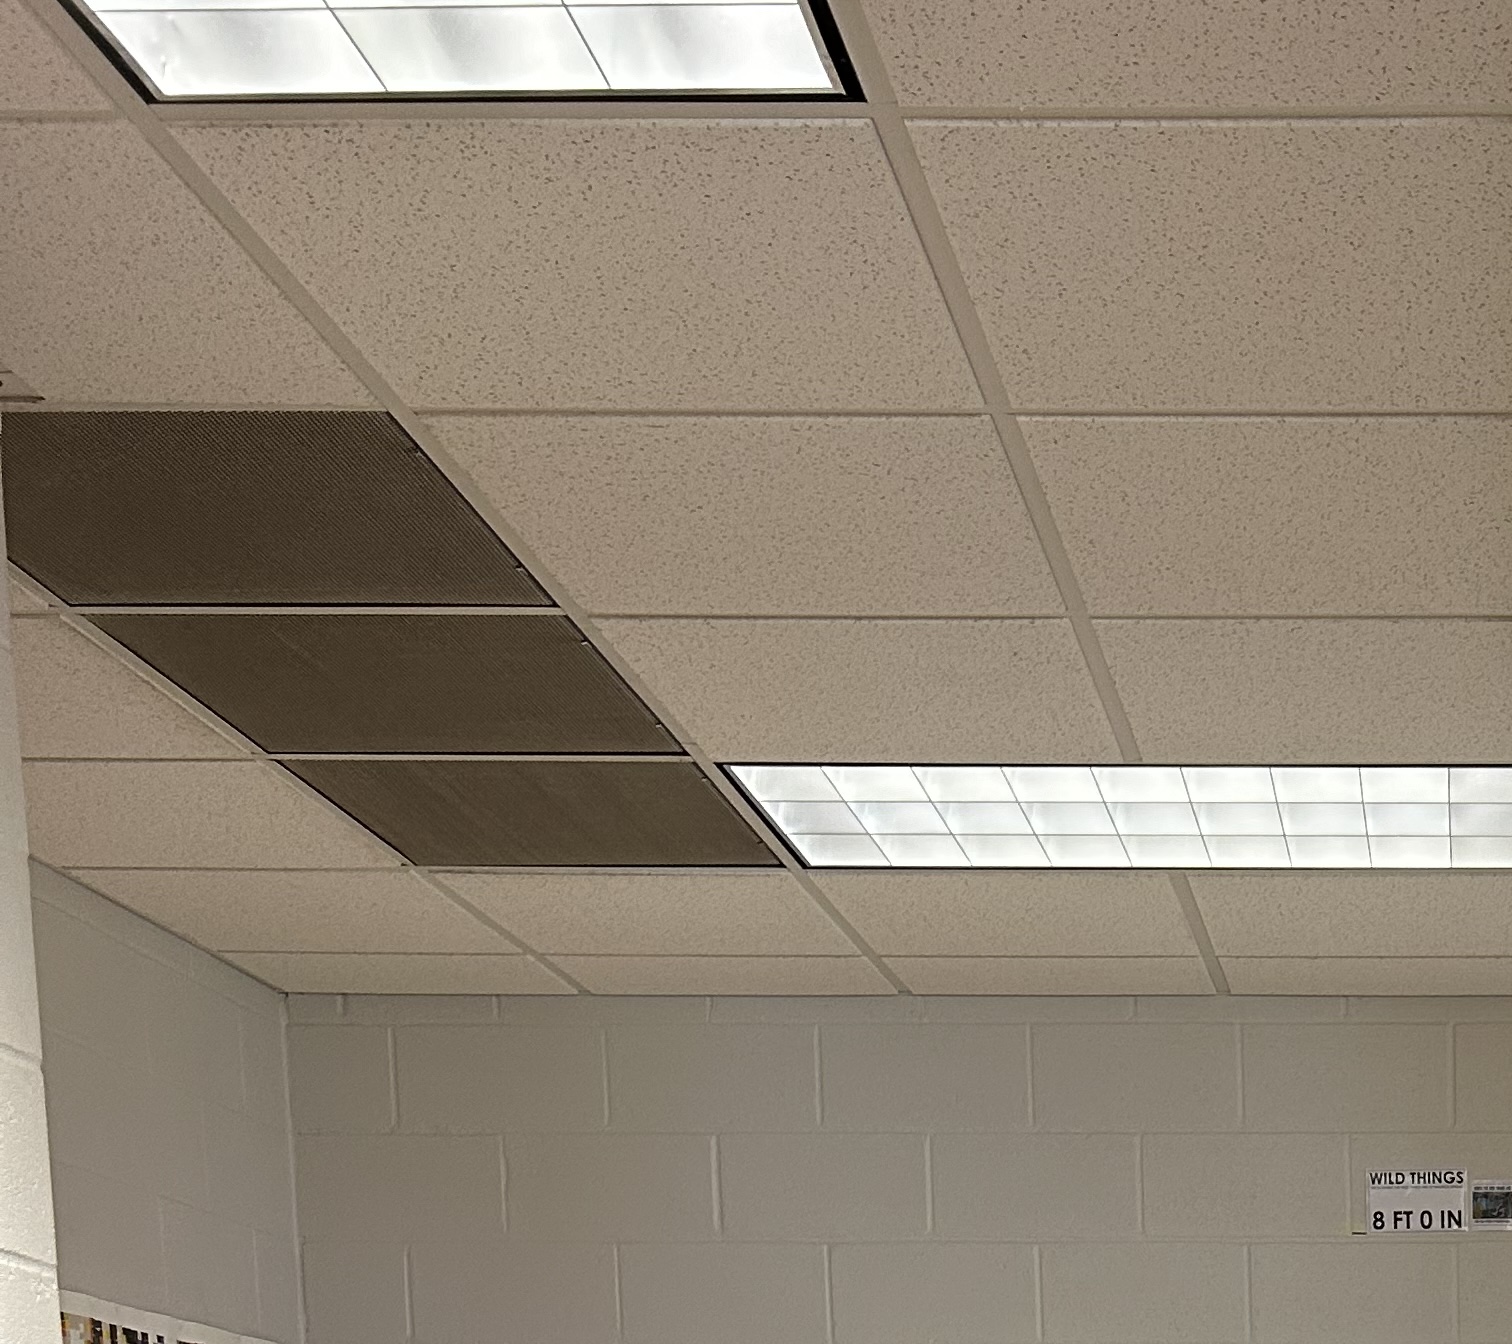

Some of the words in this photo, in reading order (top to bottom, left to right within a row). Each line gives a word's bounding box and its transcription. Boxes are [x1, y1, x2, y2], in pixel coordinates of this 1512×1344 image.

[1370, 1172, 1405, 1185] WILD
[1410, 1171, 1464, 1185] THINGS
[1373, 1211, 1385, 1230] 8
[1393, 1211, 1413, 1229] FT
[1420, 1210, 1433, 1229] 0
[1440, 1210, 1462, 1229] IN
